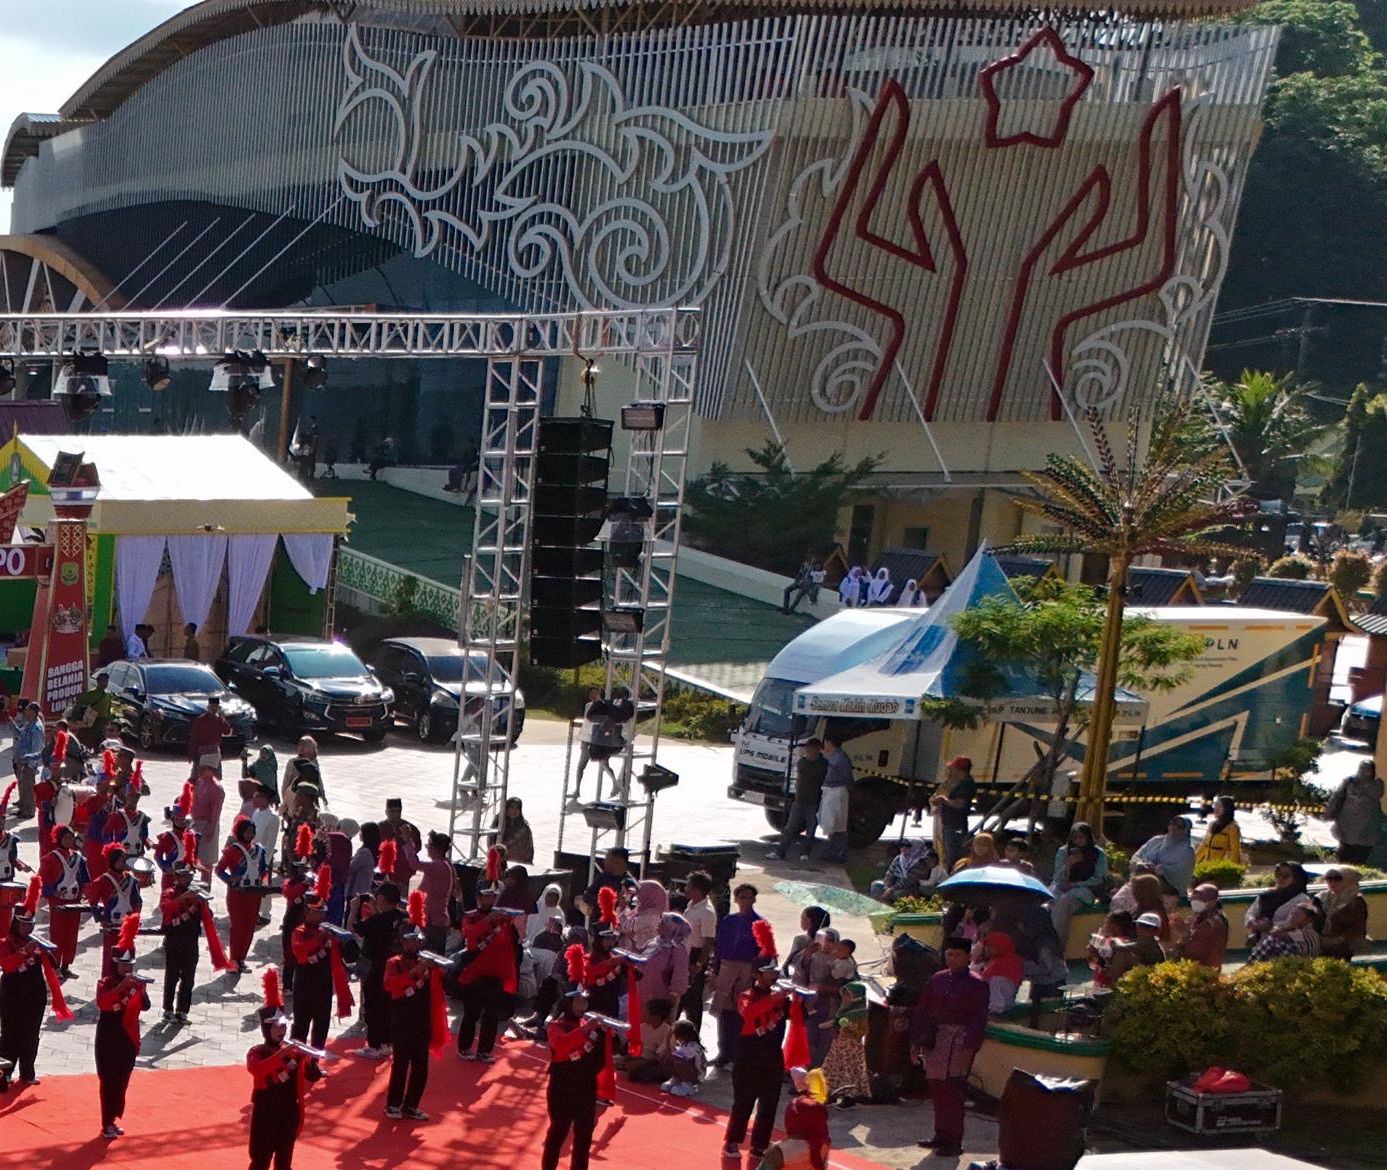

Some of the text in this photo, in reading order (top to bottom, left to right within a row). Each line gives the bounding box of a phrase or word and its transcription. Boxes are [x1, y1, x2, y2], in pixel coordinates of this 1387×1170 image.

[47, 660, 84, 679] BANGGA
[47, 671, 84, 690] BELANJA
[47, 683, 83, 702] PRODUK
[1010, 706, 1047, 715] TANJUNG
